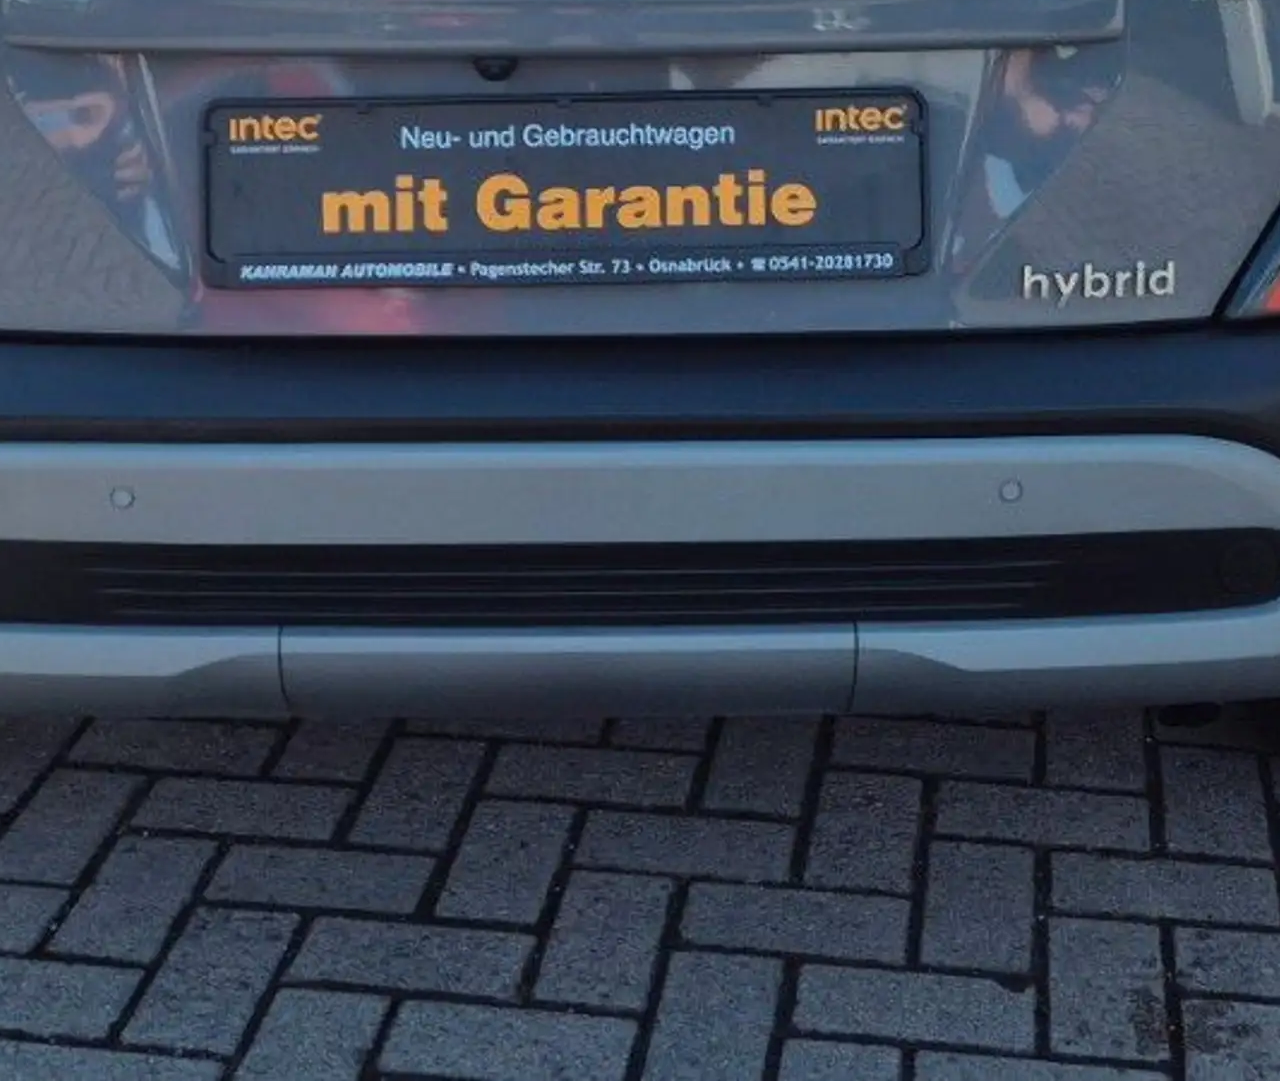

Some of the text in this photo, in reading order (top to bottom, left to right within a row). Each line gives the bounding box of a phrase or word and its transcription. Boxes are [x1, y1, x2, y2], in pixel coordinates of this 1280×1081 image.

[400, 122, 736, 150] Neu- und Gebrauchtwagen
[322, 168, 817, 234] mit Garantie
[340, 262, 454, 278] AUTOMOBILE
[471, 260, 575, 280] Pagenstecher
[578, 259, 606, 275] Str.
[611, 259, 631, 275] 73
[649, 256, 732, 274] Osnabrück
[1023, 260, 1176, 309] hybrid
